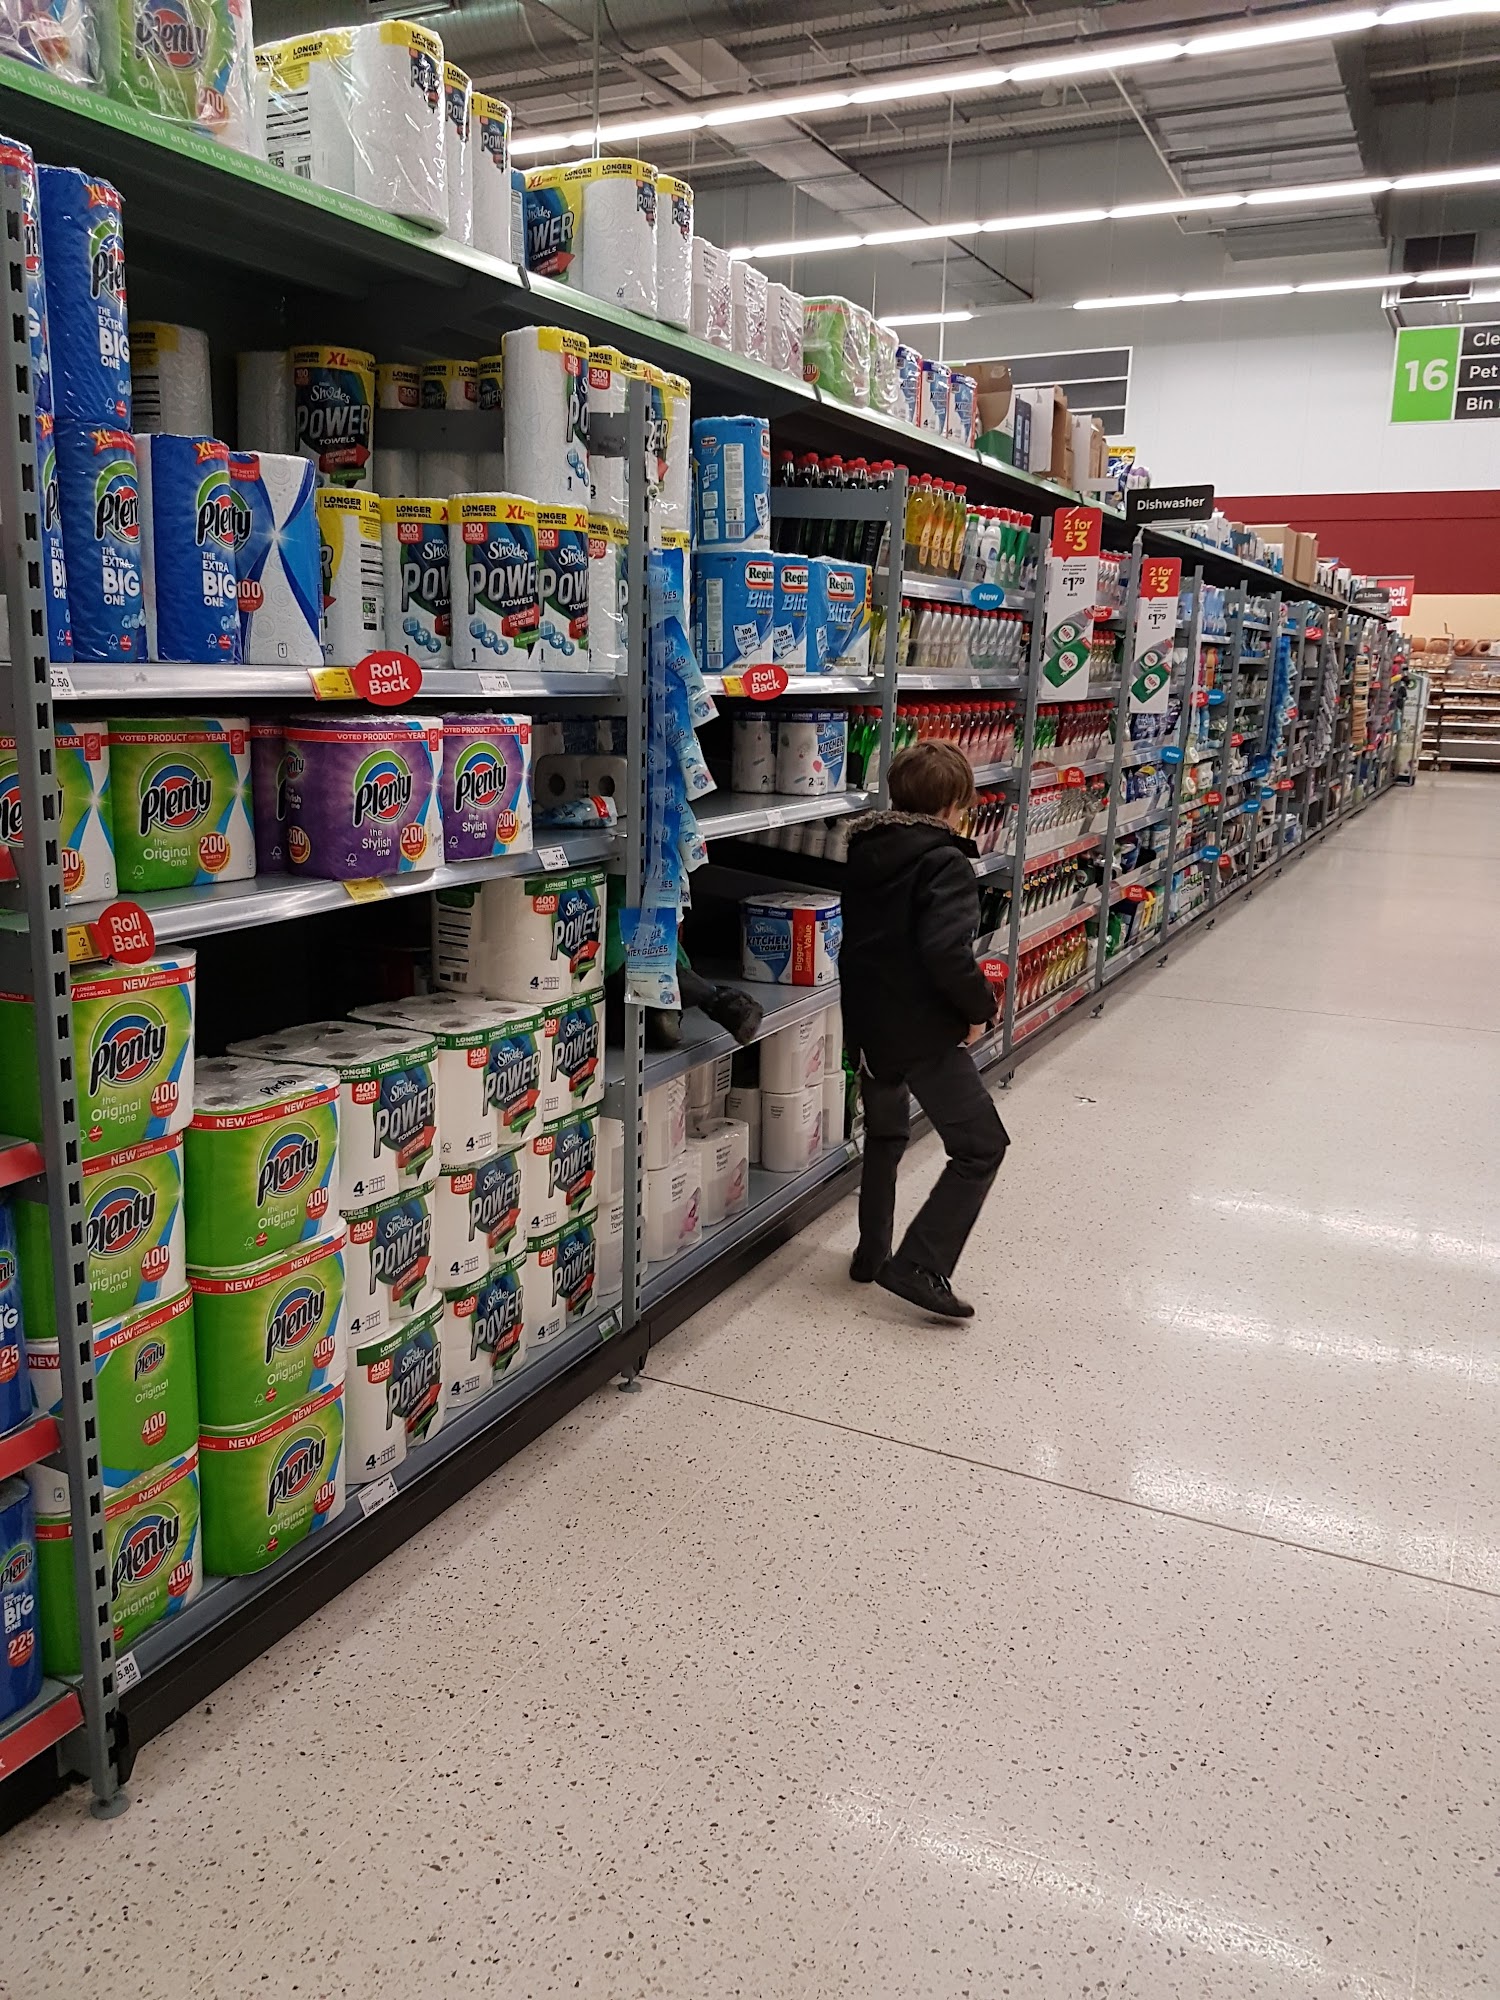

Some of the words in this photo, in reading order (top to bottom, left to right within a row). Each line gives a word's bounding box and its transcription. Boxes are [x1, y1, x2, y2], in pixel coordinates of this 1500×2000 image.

[293, 41, 323, 55] LONGER
[29, 75, 92, 109] displayed
[97, 102, 112, 115] on
[114, 109, 136, 127] this
[139, 120, 167, 138] shelf
[170, 133, 188, 147] are
[190, 139, 210, 155] not
[210, 147, 227, 163] for
[253, 164, 287, 187] Please
[289, 179, 314, 197] make
[315, 190, 337, 208] your
[338, 198, 376, 222] selection
[377, 214, 399, 232] from
[564, 167, 592, 177] LONGER
[602, 163, 632, 172] LONGER
[98, 306, 111, 317] THE
[98, 315, 124, 333] EXTRA
[99, 327, 130, 363] BIG
[100, 355, 121, 370] ONE
[326, 351, 350, 366] XL
[591, 368, 609, 379] 300
[1404, 358, 1449, 392] 16
[1469, 365, 1499, 379] Pet
[1466, 396, 1494, 411] Bin
[295, 404, 371, 452] POWER
[91, 430, 112, 446] XL
[319, 436, 356, 446] TOWELS
[197, 441, 214, 457] XL
[324, 496, 361, 506] LONGER
[1137, 497, 1205, 511] Dishwasher
[396, 505, 431, 513] LONGER
[462, 505, 497, 513] LONGER
[505, 504, 525, 520] XL
[465, 522, 483, 533] 100
[574, 513, 586, 528] XL
[1063, 520, 1072, 530] 2
[1074, 518, 1093, 529] for
[400, 523, 418, 534] 100
[588, 538, 605, 549] 300
[1065, 531, 1088, 551] £3
[102, 555, 131, 568] EXTRA
[202, 551, 216, 562] THE
[202, 560, 229, 573] EXTRA
[1150, 567, 1157, 576] 2
[1157, 566, 1173, 576] for
[102, 566, 140, 597] BIG
[202, 572, 237, 600] BIG
[828, 576, 854, 593] Regina
[1150, 577, 1169, 593] £3
[237, 581, 261, 599] 100
[979, 591, 998, 602] New
[103, 593, 126, 606] ONE
[203, 595, 225, 608] ONE
[500, 595, 533, 608] TOWELS
[826, 603, 855, 623] Blitz
[741, 626, 752, 636] 100
[777, 628, 788, 638] 100
[370, 659, 402, 678] Roll
[1062, 654, 1075, 671] FAIRY
[752, 669, 775, 683] Roll
[368, 675, 411, 695] Back
[751, 679, 781, 693] Back
[119, 734, 147, 743] VOTED
[148, 732, 188, 743] PRODUCT
[205, 731, 227, 742] YEAR
[336, 732, 362, 741] VOTED
[362, 731, 393, 741] PRODUCT
[407, 731, 426, 740] YEAR
[461, 725, 491, 734] PRODUCT
[503, 725, 518, 734] YEAR
[56, 736, 80, 747] YEAR
[817, 737, 845, 754] KITCHEN
[1166, 750, 1180, 758] New
[1068, 775, 1081, 783] Back
[454, 763, 507, 812] Plenty
[139, 775, 213, 836] Plenty
[353, 771, 412, 827] Plenty
[468, 813, 480, 821] the
[498, 812, 516, 828] 200
[369, 828, 382, 837] the
[402, 825, 424, 843] 200
[462, 820, 488, 834] Stylish
[154, 836, 168, 846] the
[473, 831, 487, 839] one
[200, 834, 226, 854] 200
[361, 835, 392, 851] Stylish
[143, 844, 191, 862] Original
[376, 848, 391, 857] one
[170, 857, 188, 867] one
[534, 895, 556, 906] 400
[1129, 891, 1143, 899] Back
[110, 912, 141, 934] Roll
[551, 906, 601, 960] POWER
[804, 923, 812, 948] Value
[111, 931, 150, 953] Back
[759, 943, 791, 951] TOWELS
[795, 941, 803, 973] Bigger
[984, 969, 1003, 978] Back
[986, 963, 1001, 972] Roll
[122, 976, 150, 992] NEW
[529, 976, 539, 988] 4
[89, 1024, 167, 1097] Plenty
[151, 1082, 178, 1103] 400
[354, 1081, 377, 1093] 400
[101, 1095, 117, 1104] the
[91, 1098, 142, 1122] Original
[118, 1112, 137, 1125] one
[216, 1117, 247, 1128] NEW
[110, 1149, 137, 1166] NEW
[256, 1138, 319, 1207] Plenty
[306, 1187, 328, 1209] 400
[267, 1204, 280, 1213] the
[258, 1205, 299, 1229] Original
[141, 1246, 170, 1268] 400
[92, 1266, 107, 1276] the
[109, 1280, 128, 1294] one
[224, 1280, 254, 1292] NEW
[265, 1289, 326, 1365] Plenty
[109, 1327, 134, 1348] NEW
[313, 1337, 335, 1358] 400
[28, 1357, 60, 1367] NEW
[134, 1342, 166, 1382] Plenty
[371, 1358, 390, 1371] 400
[266, 1356, 307, 1386] Original
[135, 1379, 169, 1403] Original
[141, 1411, 167, 1436] 400
[228, 1436, 258, 1449] NEW
[267, 1441, 326, 1516] Plenty
[138, 1485, 163, 1503] NEW
[314, 1482, 336, 1504] 400
[269, 1507, 308, 1536] Original
[111, 1513, 180, 1602] Plenty
[167, 1560, 193, 1587] 400
[4, 1594, 35, 1628] BIG
[113, 1587, 160, 1623] Original
[8, 1627, 35, 1659] 225
